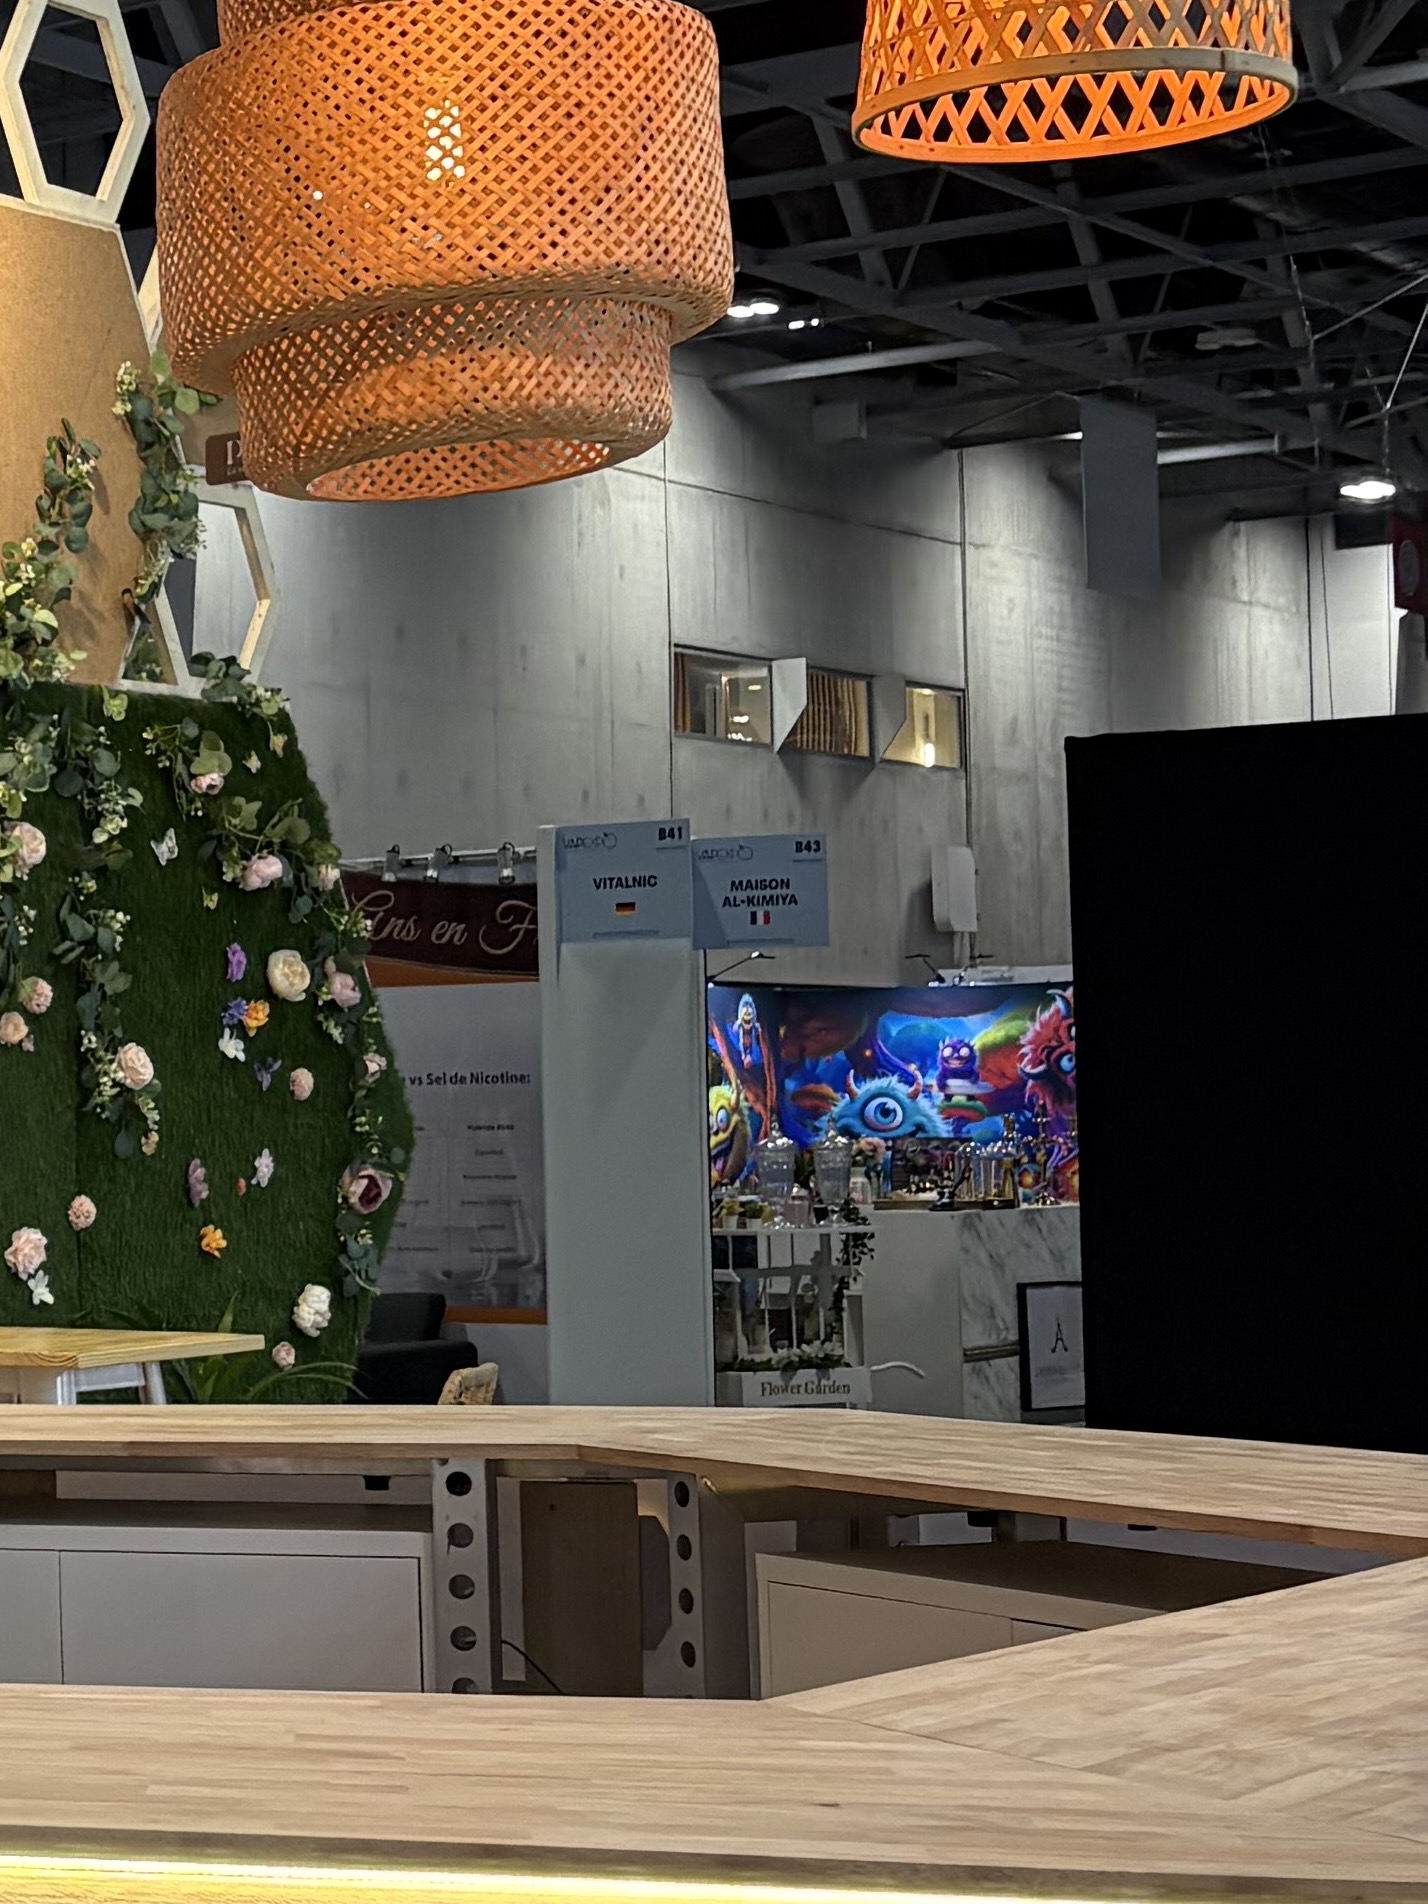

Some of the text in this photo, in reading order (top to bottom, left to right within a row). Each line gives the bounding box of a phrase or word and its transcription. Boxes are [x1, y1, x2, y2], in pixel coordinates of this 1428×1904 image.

[658, 826, 683, 841] B41
[795, 840, 821, 854] B43
[593, 875, 658, 891] VITALNIC
[730, 878, 790, 893] MAISON
[722, 893, 798, 908] AL-KIMIYA
[431, 920, 468, 946] en
[479, 900, 538, 955] F
[409, 1075, 423, 1086] vs
[426, 1071, 446, 1086] Sel
[449, 1071, 467, 1086] de
[761, 1379, 850, 1397] Flower Garden
